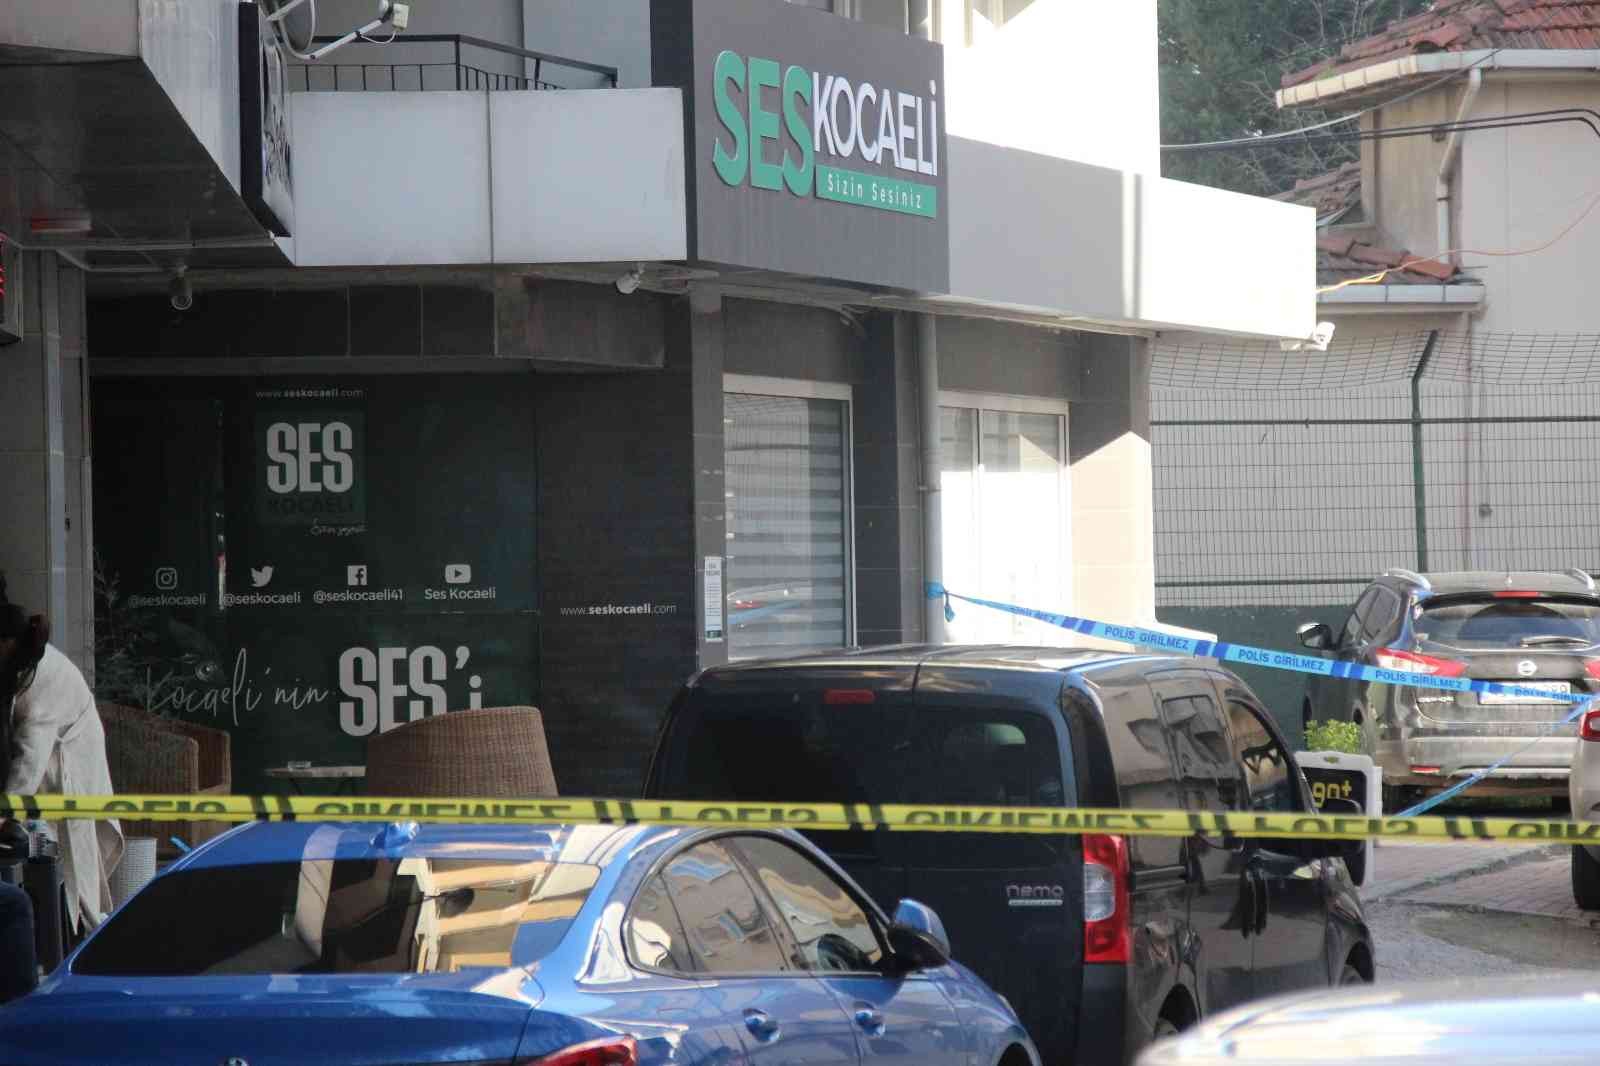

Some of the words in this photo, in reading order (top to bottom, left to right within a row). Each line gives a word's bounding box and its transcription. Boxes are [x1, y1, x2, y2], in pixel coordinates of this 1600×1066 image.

[712, 50, 815, 198] SES
[827, 173, 863, 199] Sizin
[872, 183, 922, 209] Sesiniz
[266, 421, 354, 495] SES
[313, 588, 404, 604] @seskocaeli41
[424, 588, 447, 600] Ses
[450, 586, 497, 600] Kocaeli
[560, 603, 677, 617] www.seskocaeli.com
[1006, 884, 1064, 898] nemo
